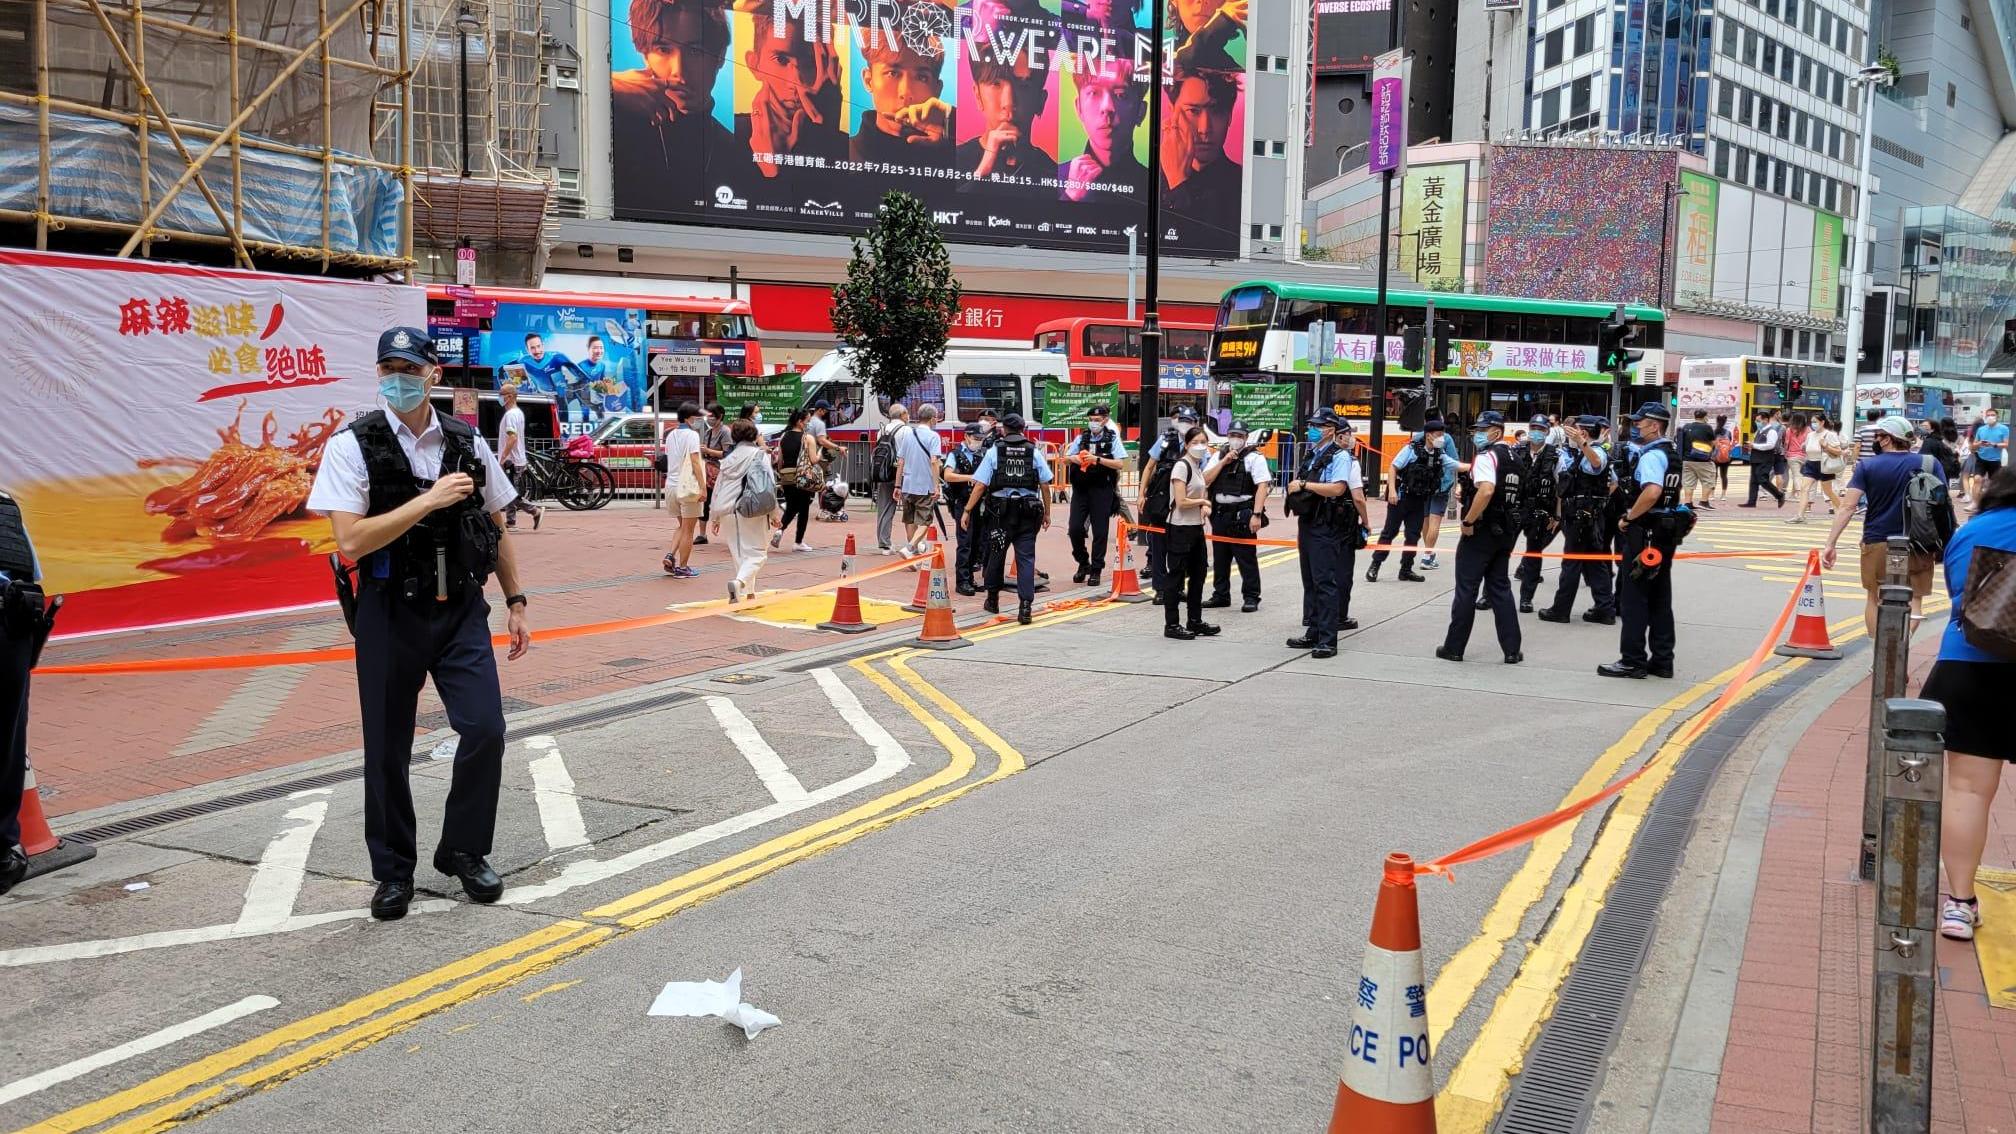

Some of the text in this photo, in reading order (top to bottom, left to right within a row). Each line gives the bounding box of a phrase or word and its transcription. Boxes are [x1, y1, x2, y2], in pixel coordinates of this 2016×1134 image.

[1047, 20, 1062, 28] LIVE
[933, 211, 960, 225] HKT
[1419, 176, 1445, 275] 黃金廣場
[436, 337, 464, 353] 品牌
[1243, 340, 1258, 358] 914
[1506, 346, 1586, 370] 記緊做年檢
